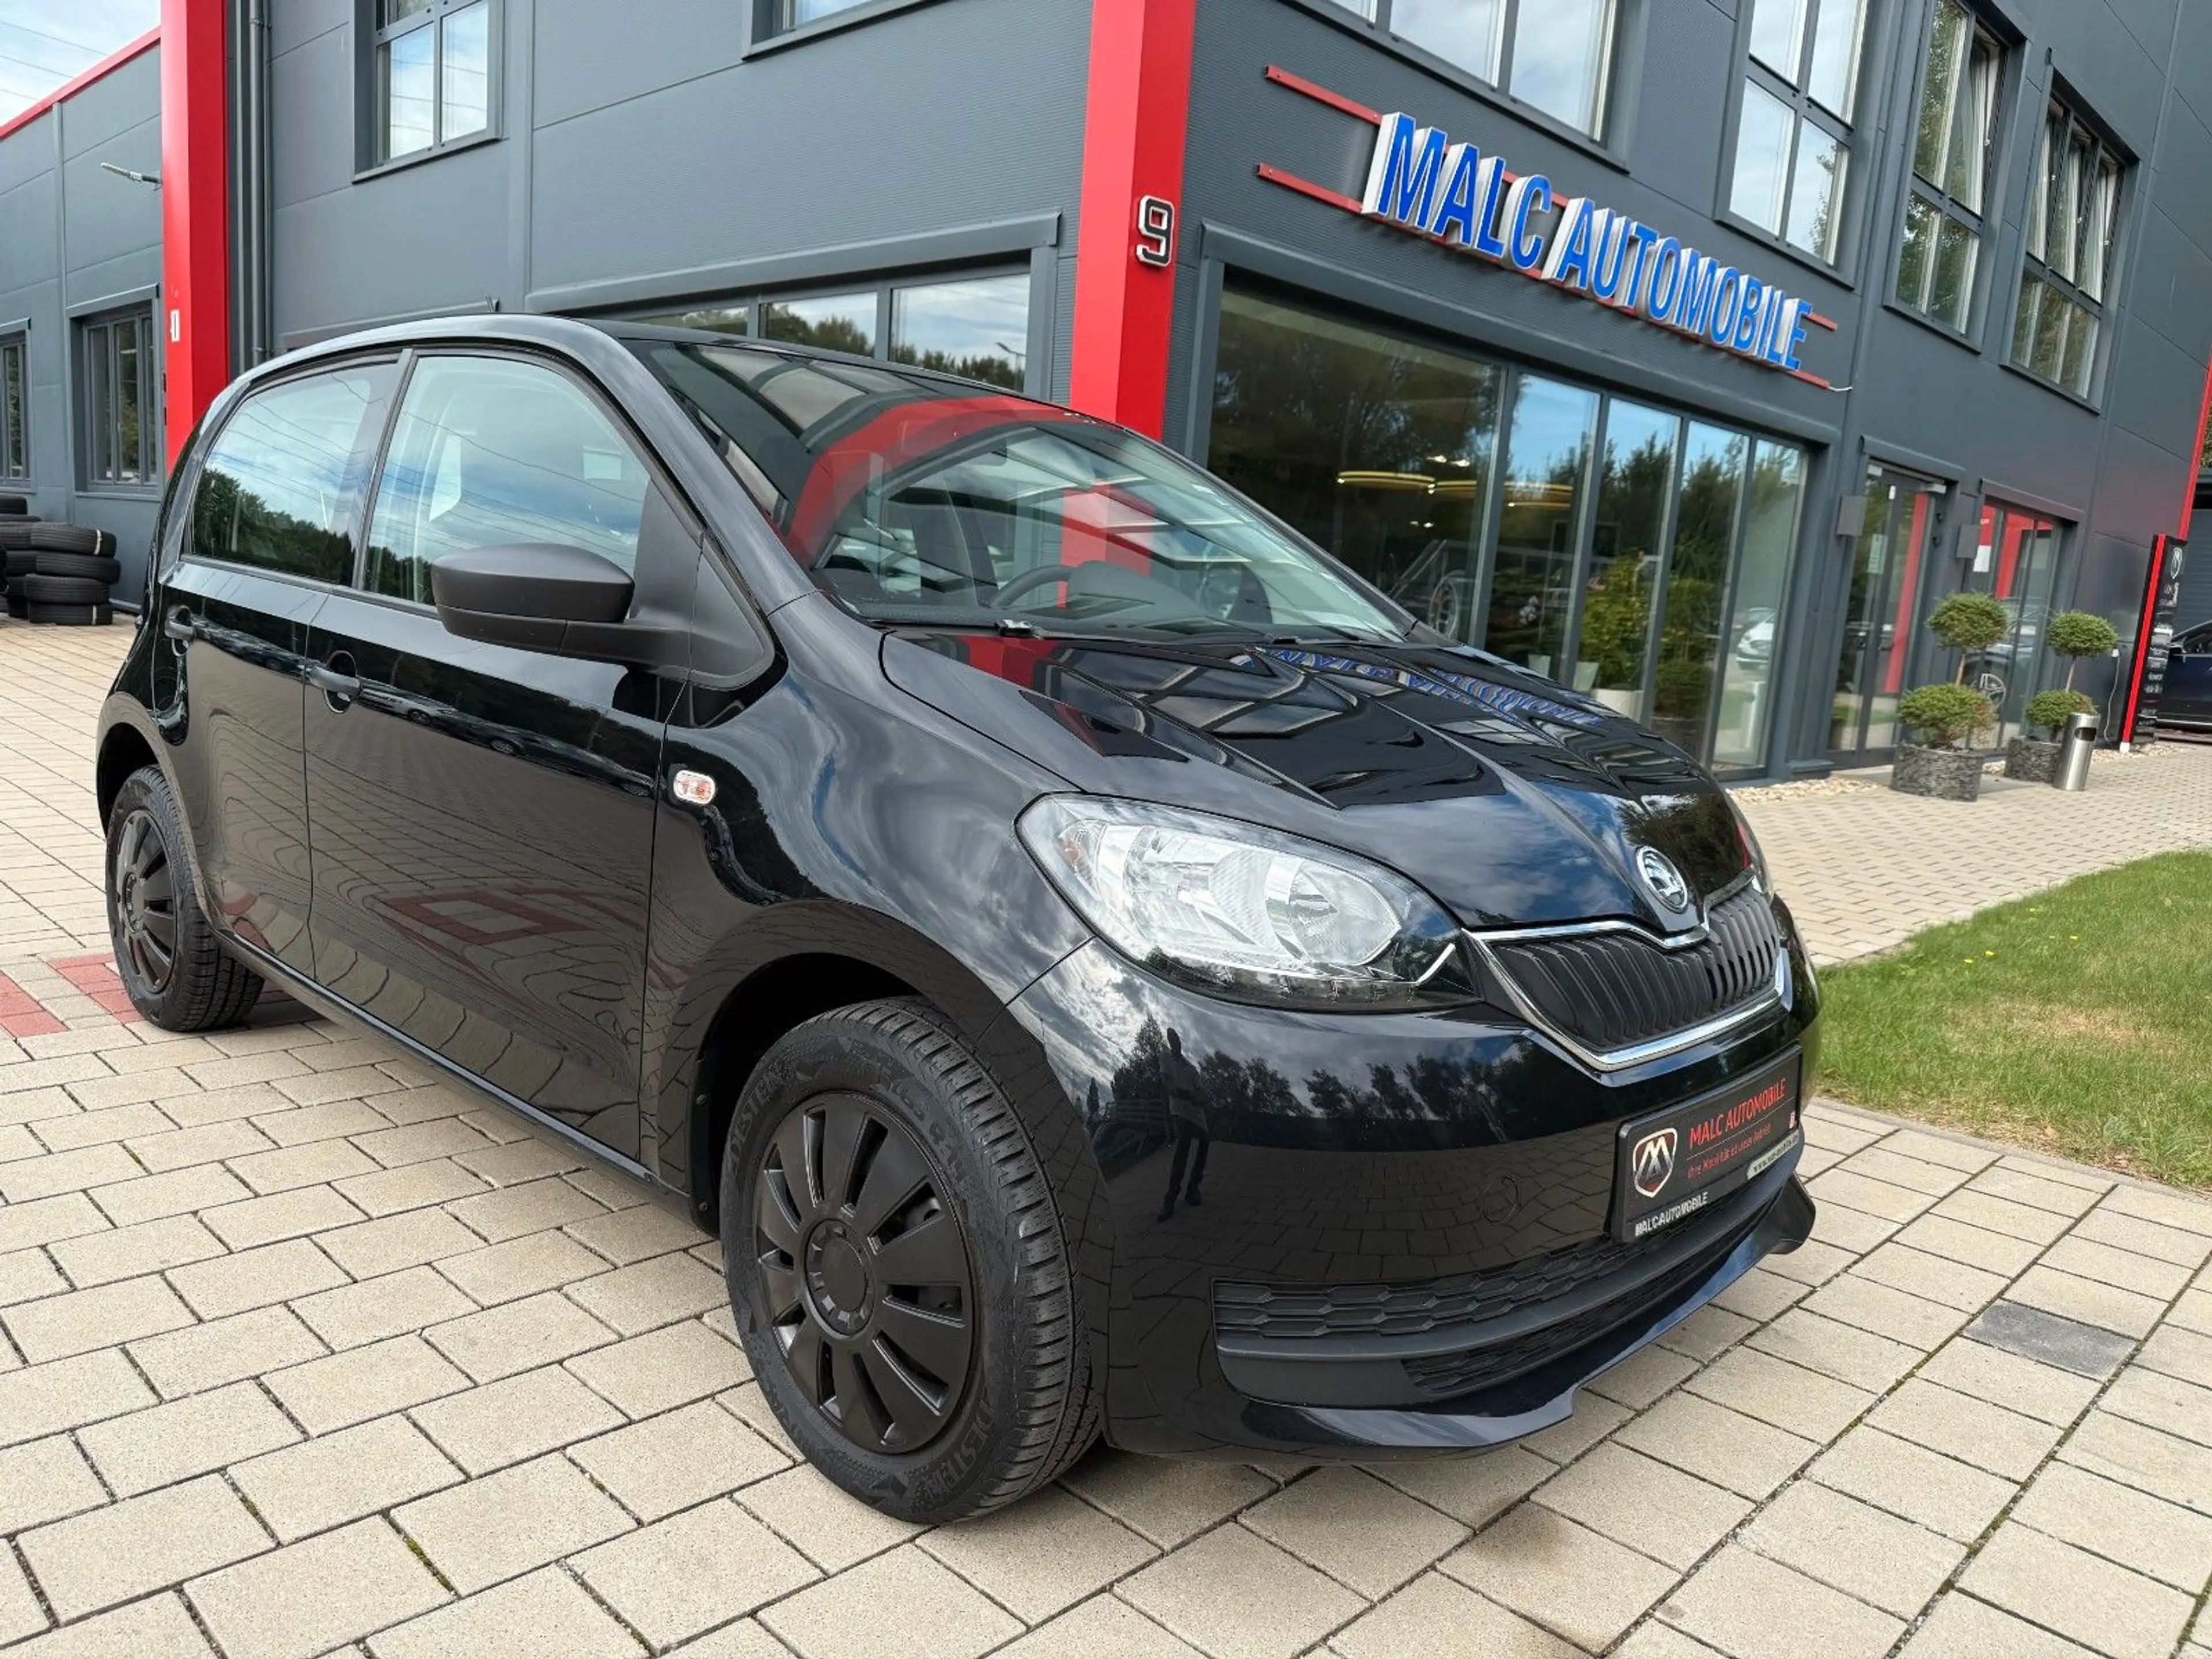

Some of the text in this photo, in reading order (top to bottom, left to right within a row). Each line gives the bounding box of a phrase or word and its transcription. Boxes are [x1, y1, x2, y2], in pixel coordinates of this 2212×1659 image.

[1137, 195, 1175, 267] 9
[1362, 112, 1812, 372] MALC AUTOMOBILE
[1688, 1113, 1724, 1150] MALC
[1725, 1077, 1786, 1132] AUTOMOBILE
